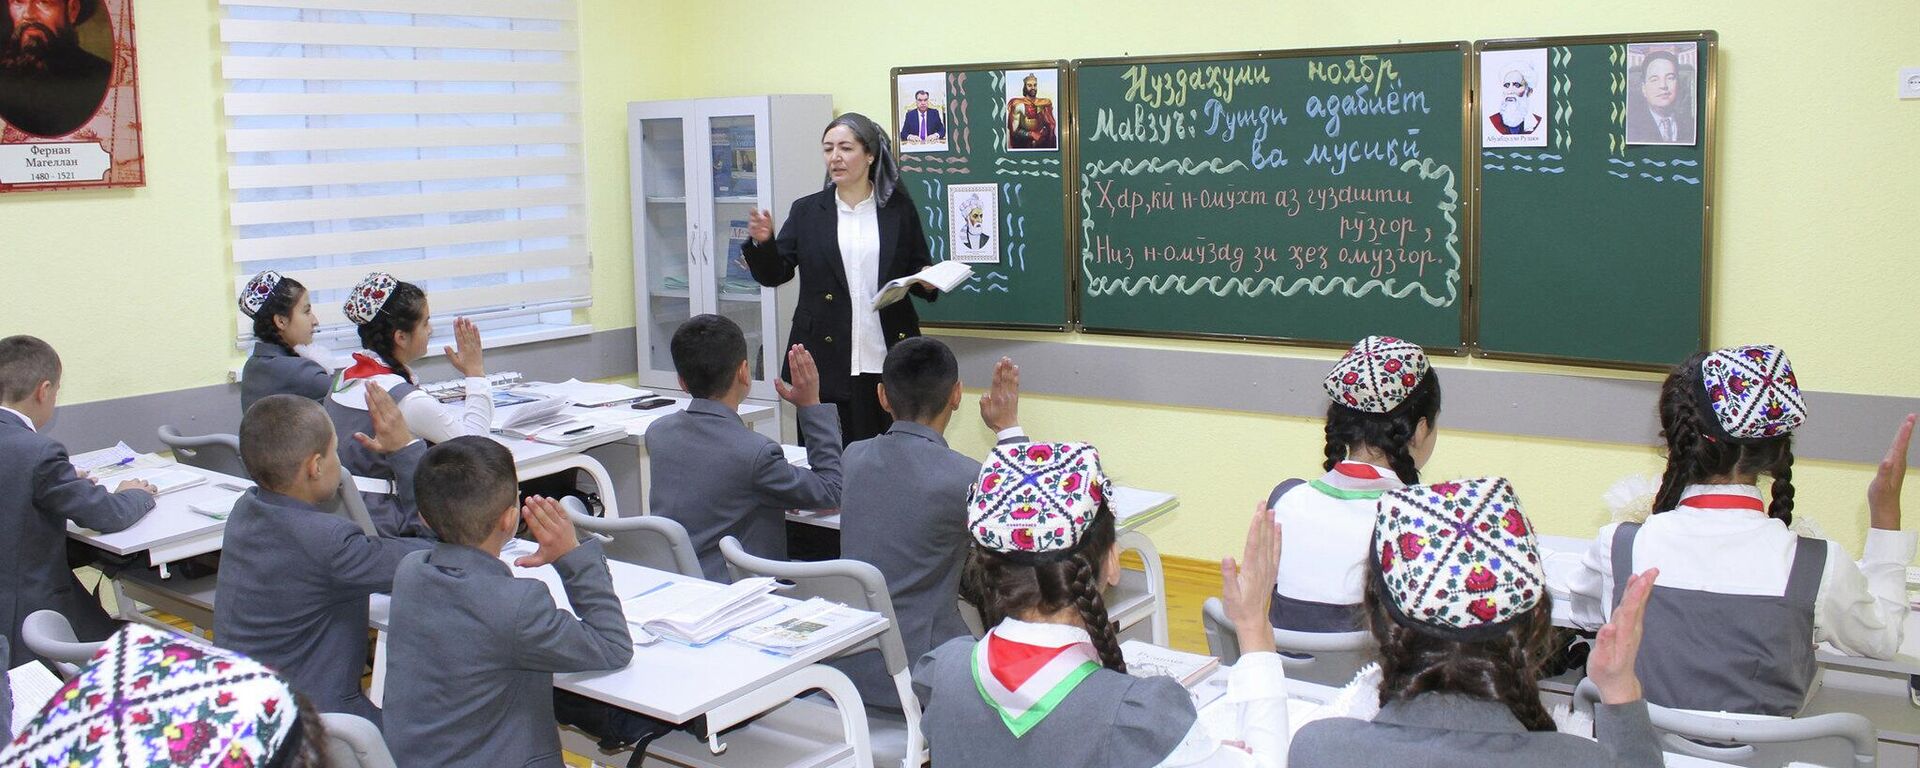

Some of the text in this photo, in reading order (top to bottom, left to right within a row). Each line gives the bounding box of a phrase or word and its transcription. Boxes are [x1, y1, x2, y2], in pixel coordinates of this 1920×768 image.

[1308, 54, 1399, 97] ноябр
[1203, 98, 1289, 143] Рушди
[1305, 78, 1431, 138] адабиёт
[25, 158, 78, 168] Магеллан
[30, 145, 71, 157] Фернан
[1251, 138, 1289, 170] ва
[31, 172, 50, 181] 1480
[57, 171, 75, 180] 1521
[1275, 189, 1301, 217] аз
[1308, 186, 1413, 211] гузашти
[1096, 234, 1135, 270] Низ
[1253, 246, 1278, 273] зи
